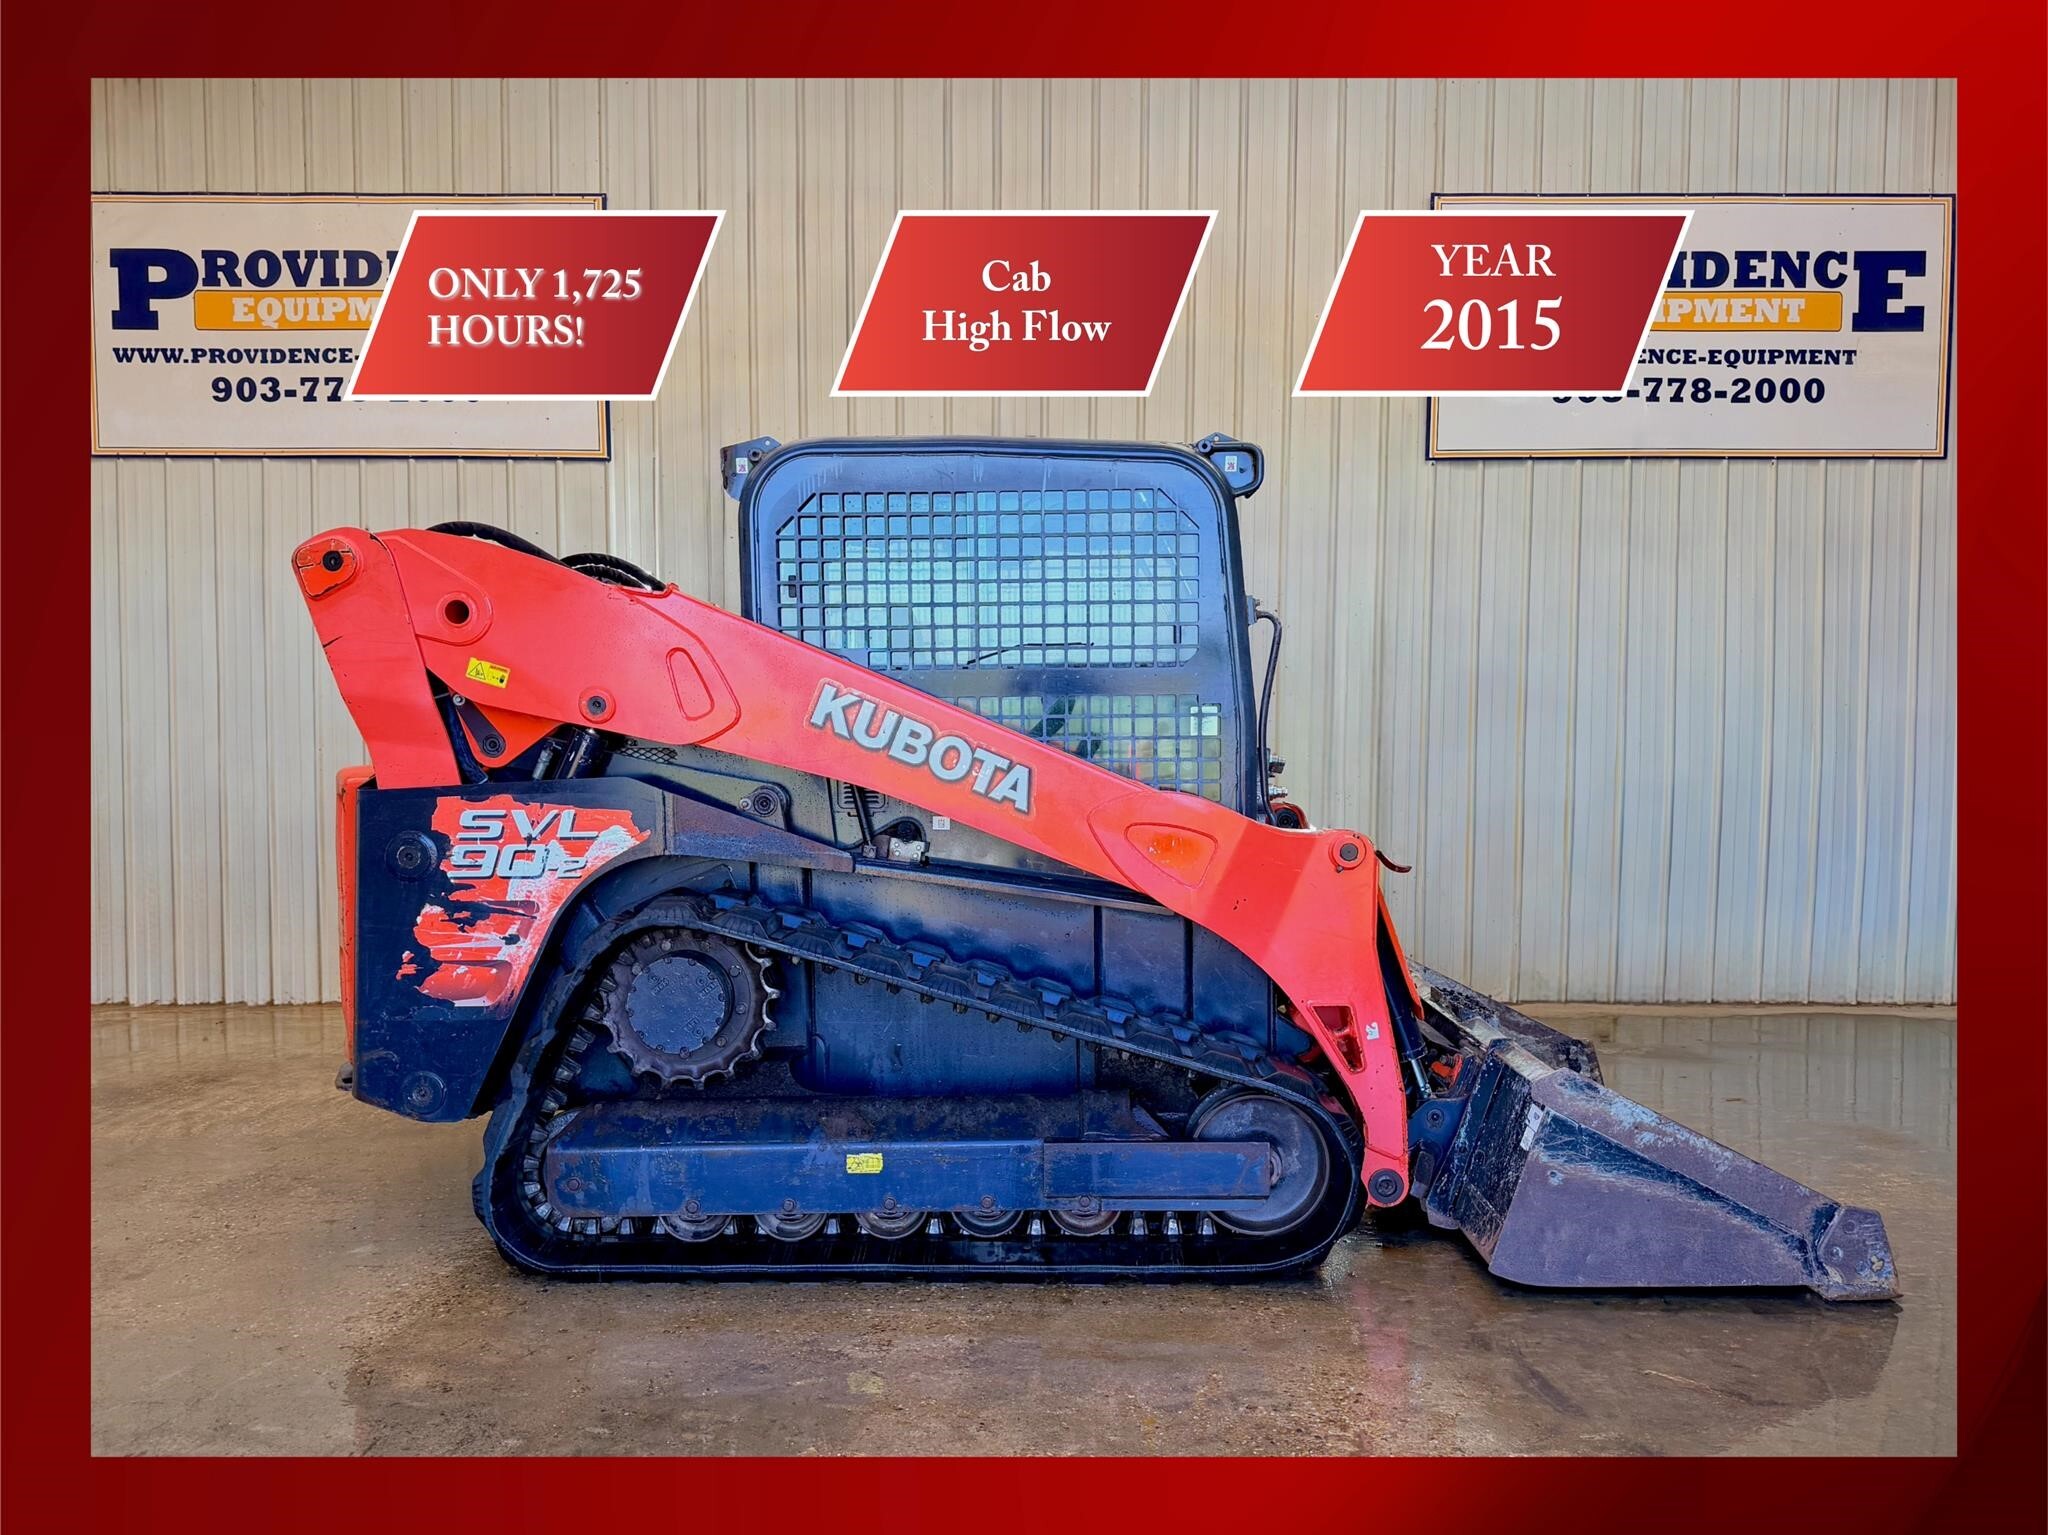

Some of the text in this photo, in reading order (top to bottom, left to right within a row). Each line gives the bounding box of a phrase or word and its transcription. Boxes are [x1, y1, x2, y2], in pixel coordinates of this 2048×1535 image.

[1552, 377, 1826, 404] -778-2000
[809, 683, 1032, 815] KUBOTA
[456, 809, 600, 840] SVL
